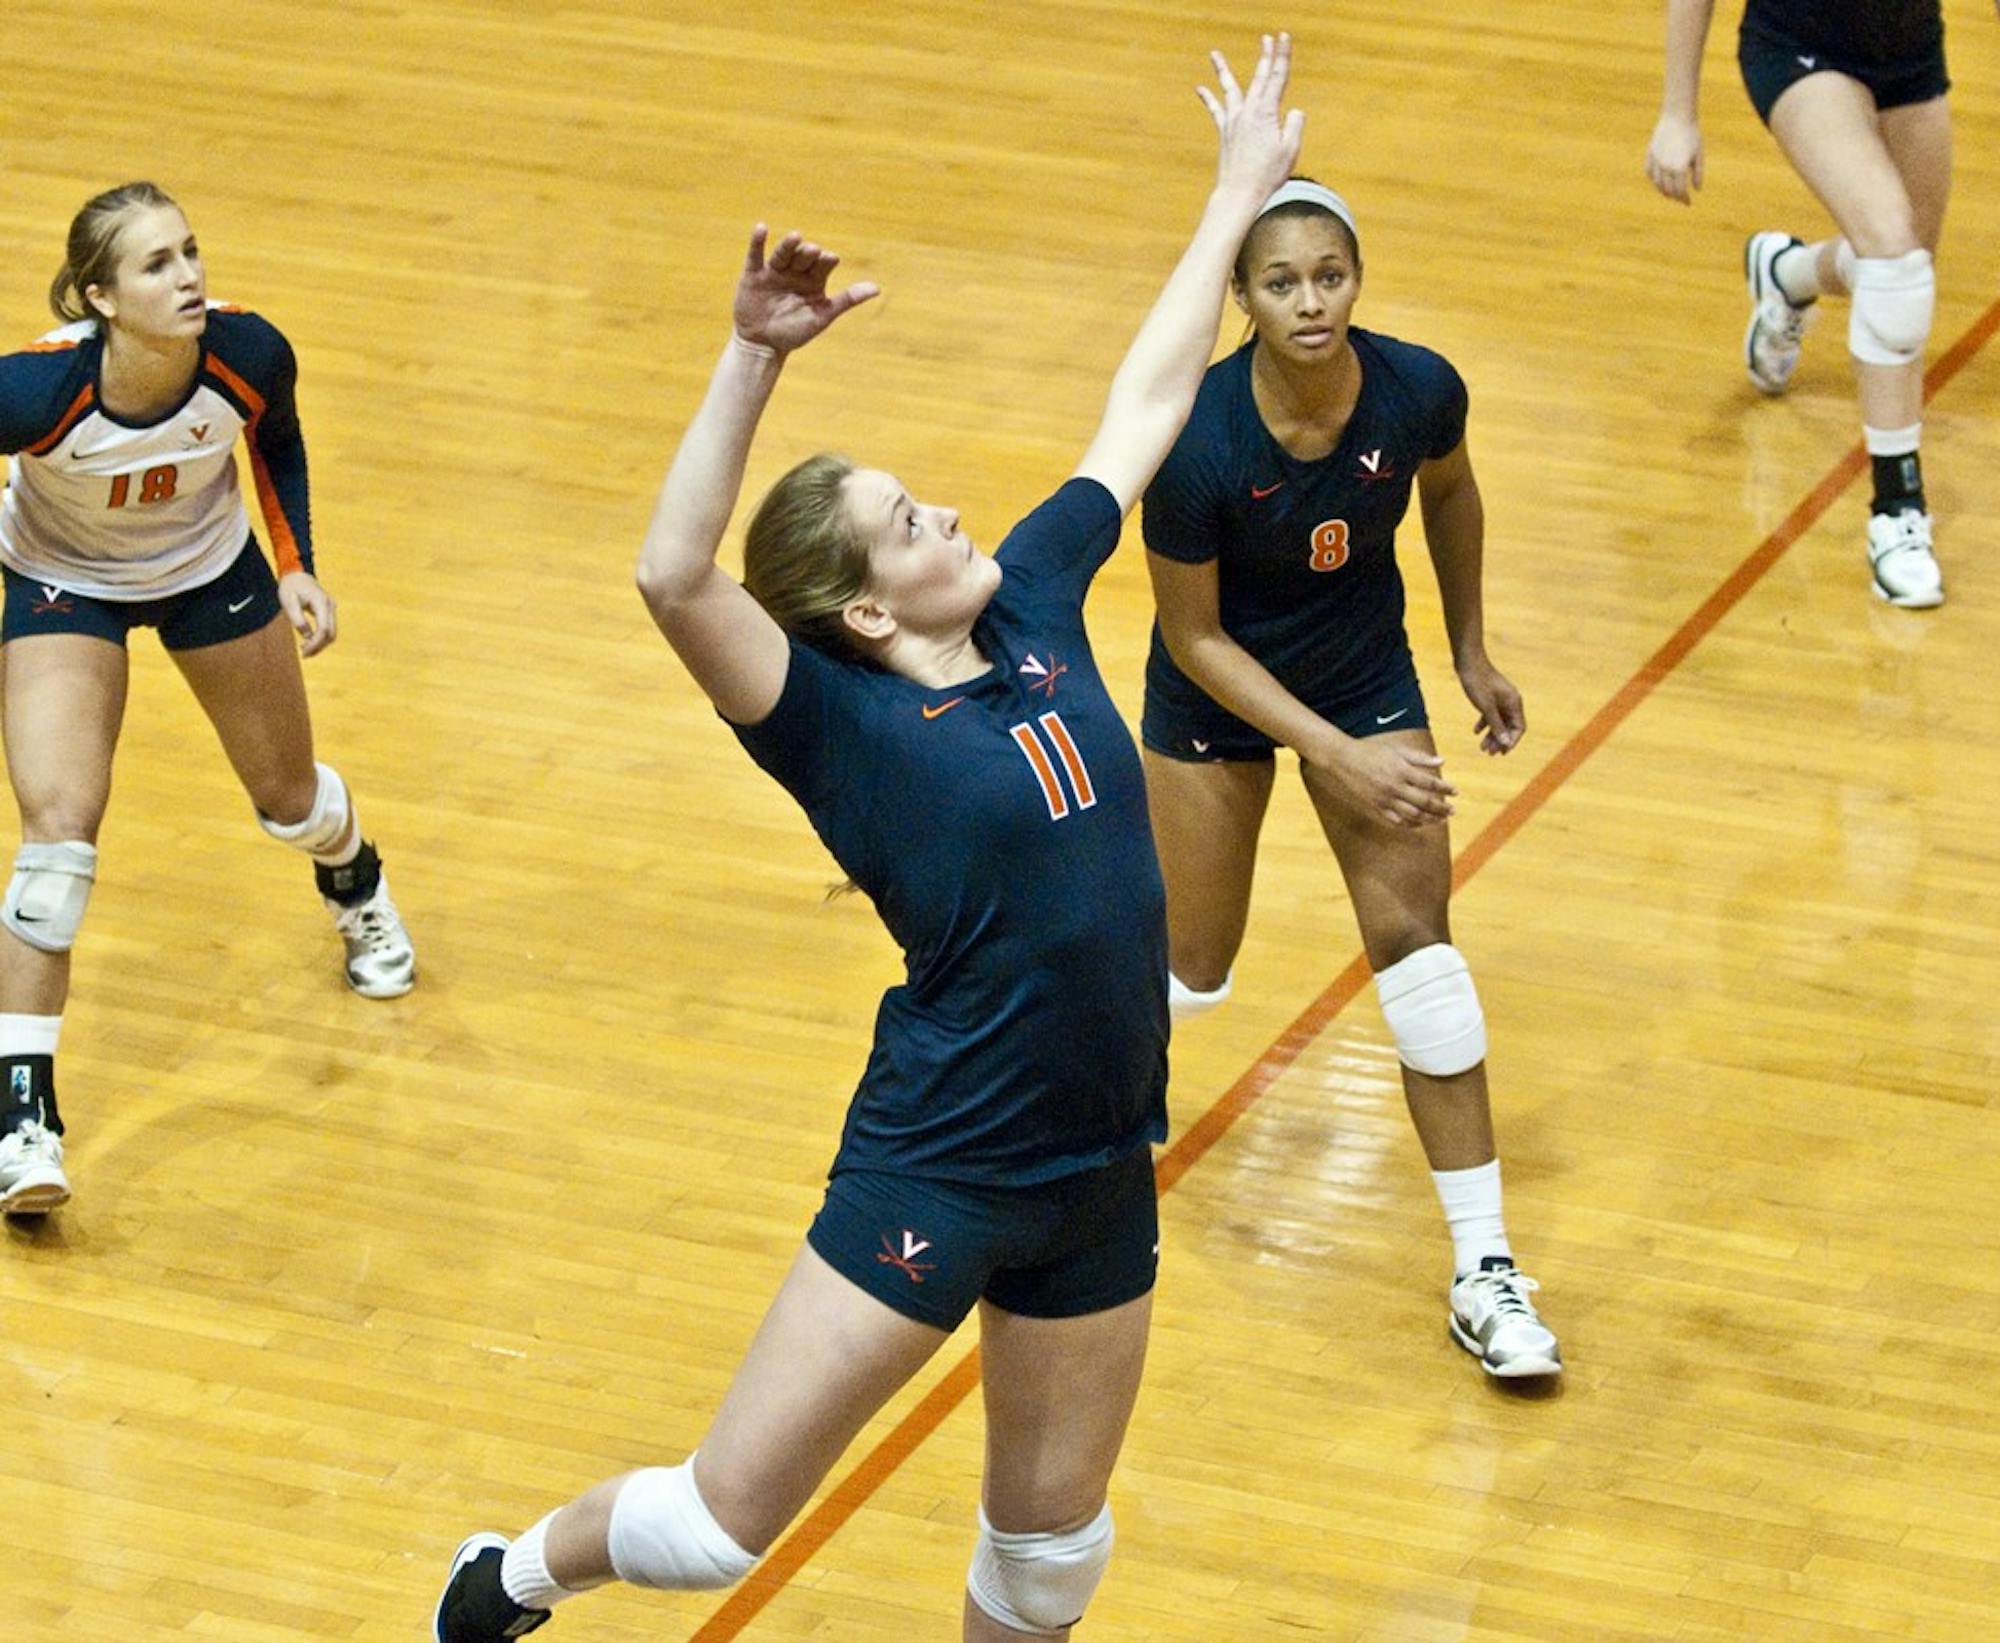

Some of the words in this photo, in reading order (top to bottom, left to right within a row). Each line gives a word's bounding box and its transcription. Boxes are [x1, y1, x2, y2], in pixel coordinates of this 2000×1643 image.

[107, 464, 177, 509] 18
[1310, 518, 1350, 572] 8
[1009, 711, 1098, 821] 11
